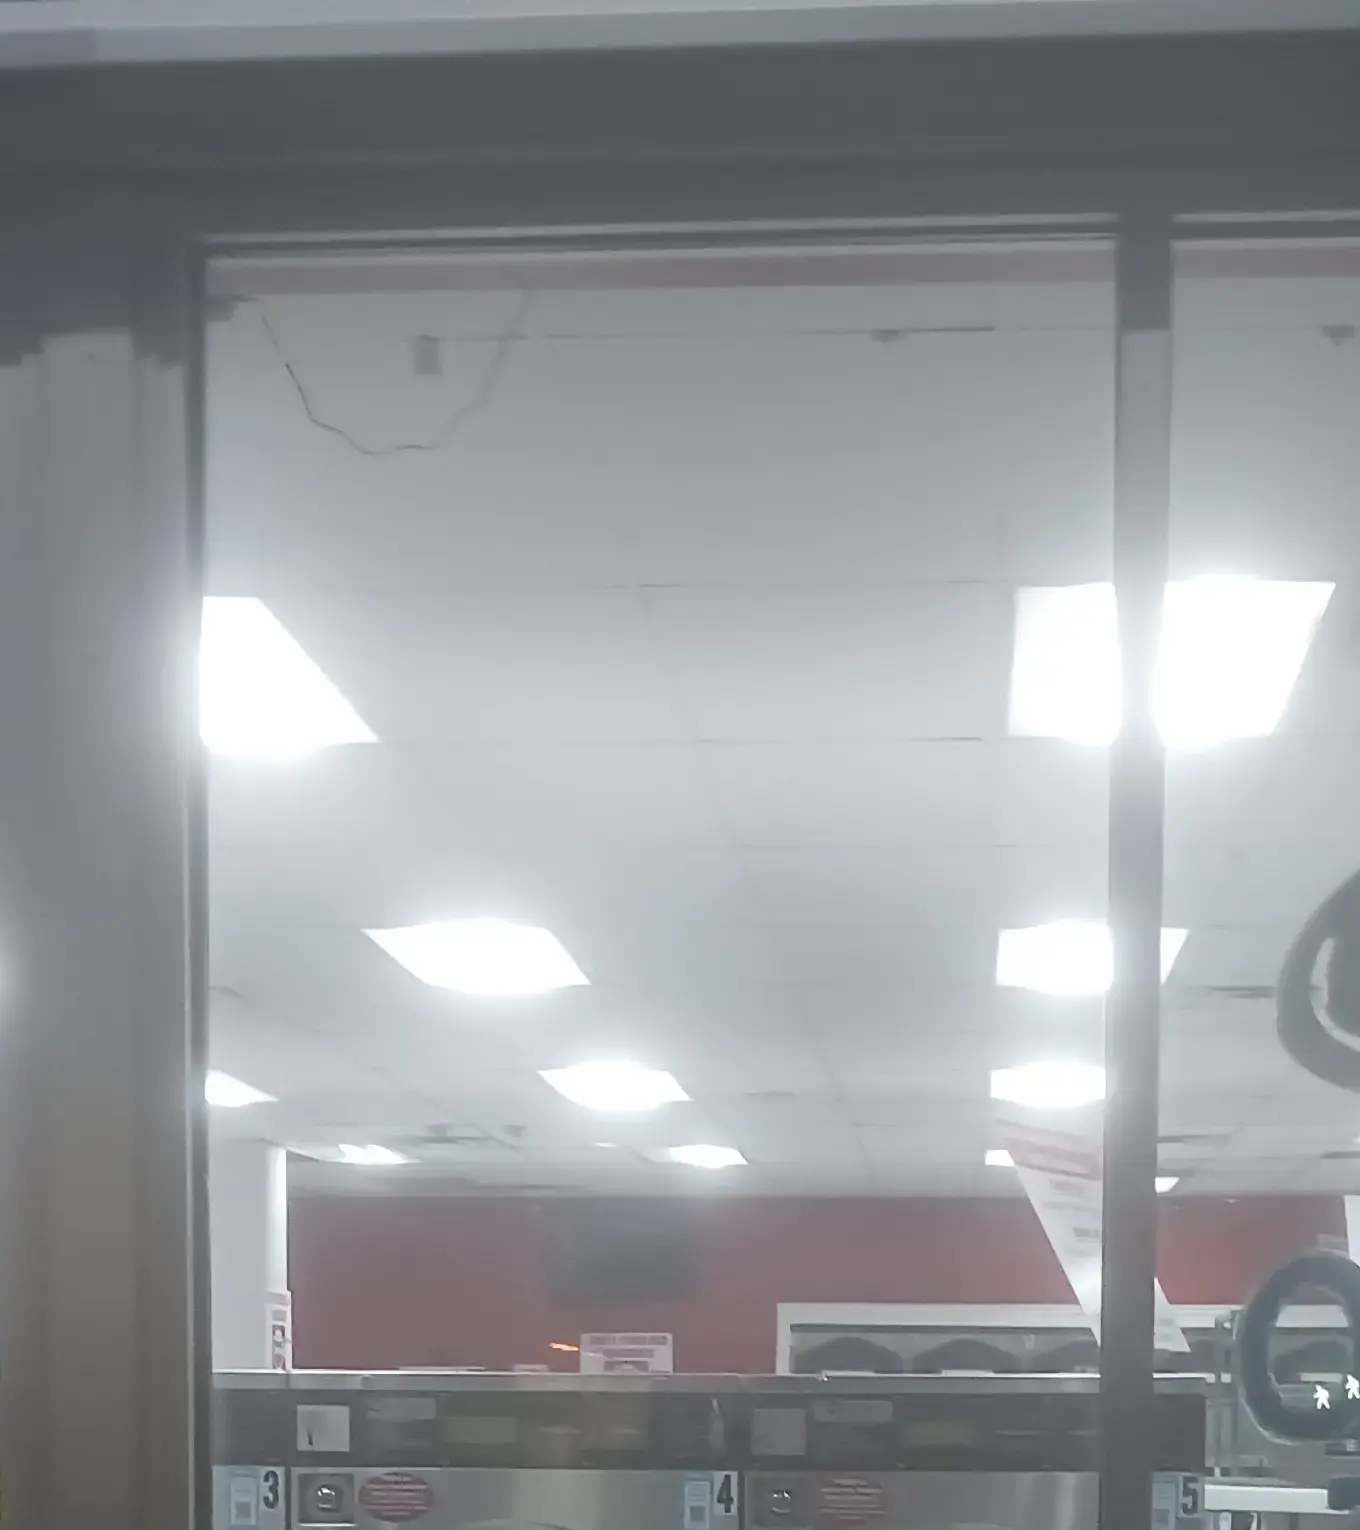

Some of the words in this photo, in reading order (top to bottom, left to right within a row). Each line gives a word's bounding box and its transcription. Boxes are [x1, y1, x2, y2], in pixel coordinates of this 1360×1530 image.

[263, 1470, 280, 1509] 3
[717, 1474, 734, 1513] 4
[1181, 1475, 1199, 1516] 5
